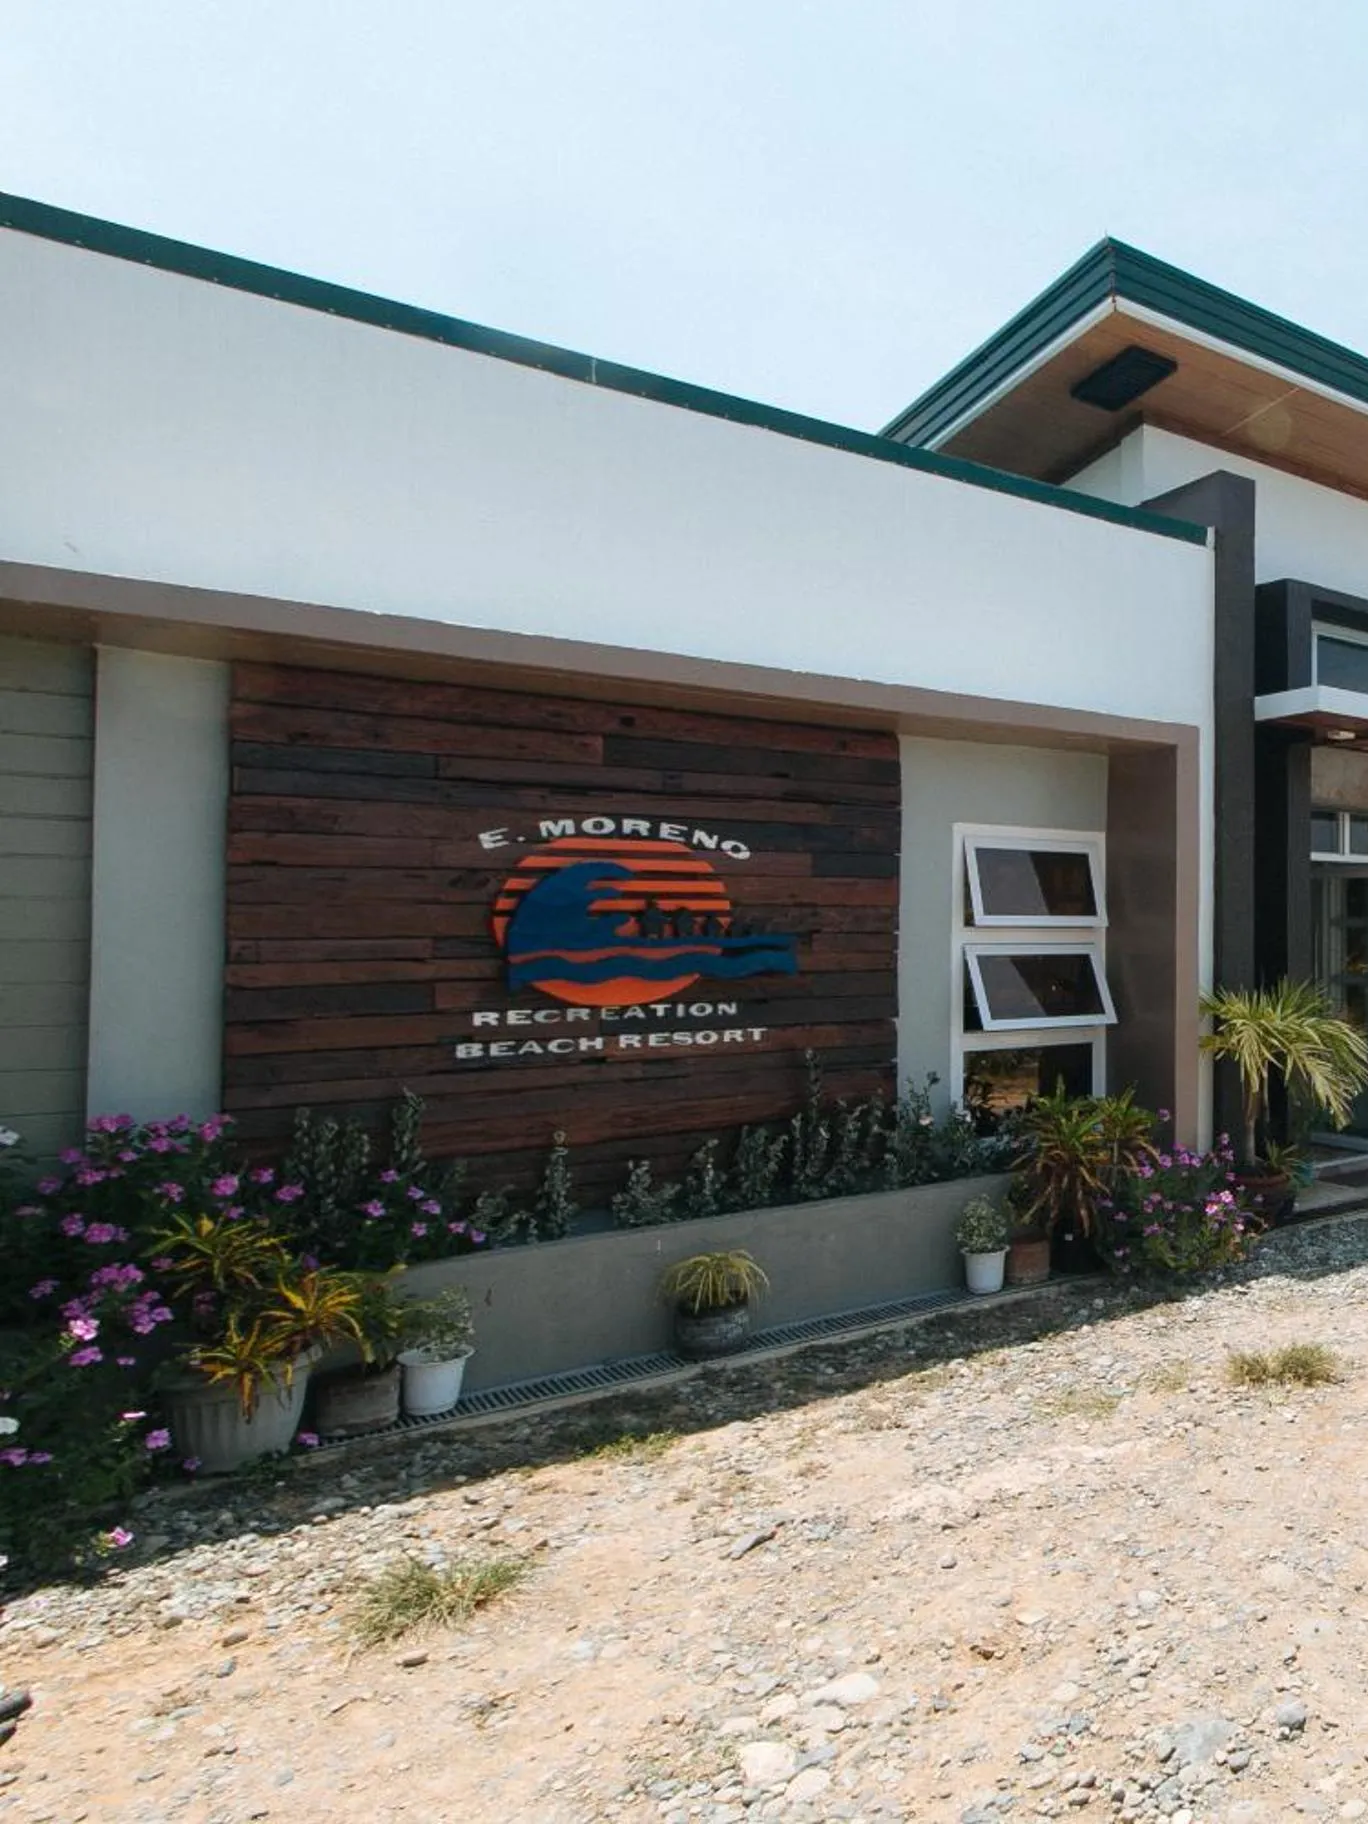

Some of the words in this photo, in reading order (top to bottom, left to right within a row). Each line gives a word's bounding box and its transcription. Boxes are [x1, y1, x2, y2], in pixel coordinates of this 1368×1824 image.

[477, 827, 526, 850] E.
[539, 816, 752, 861] MORENO
[472, 1001, 738, 1027] RECREATION
[455, 1035, 604, 1060] BEACH
[618, 1027, 768, 1050] RESORT
